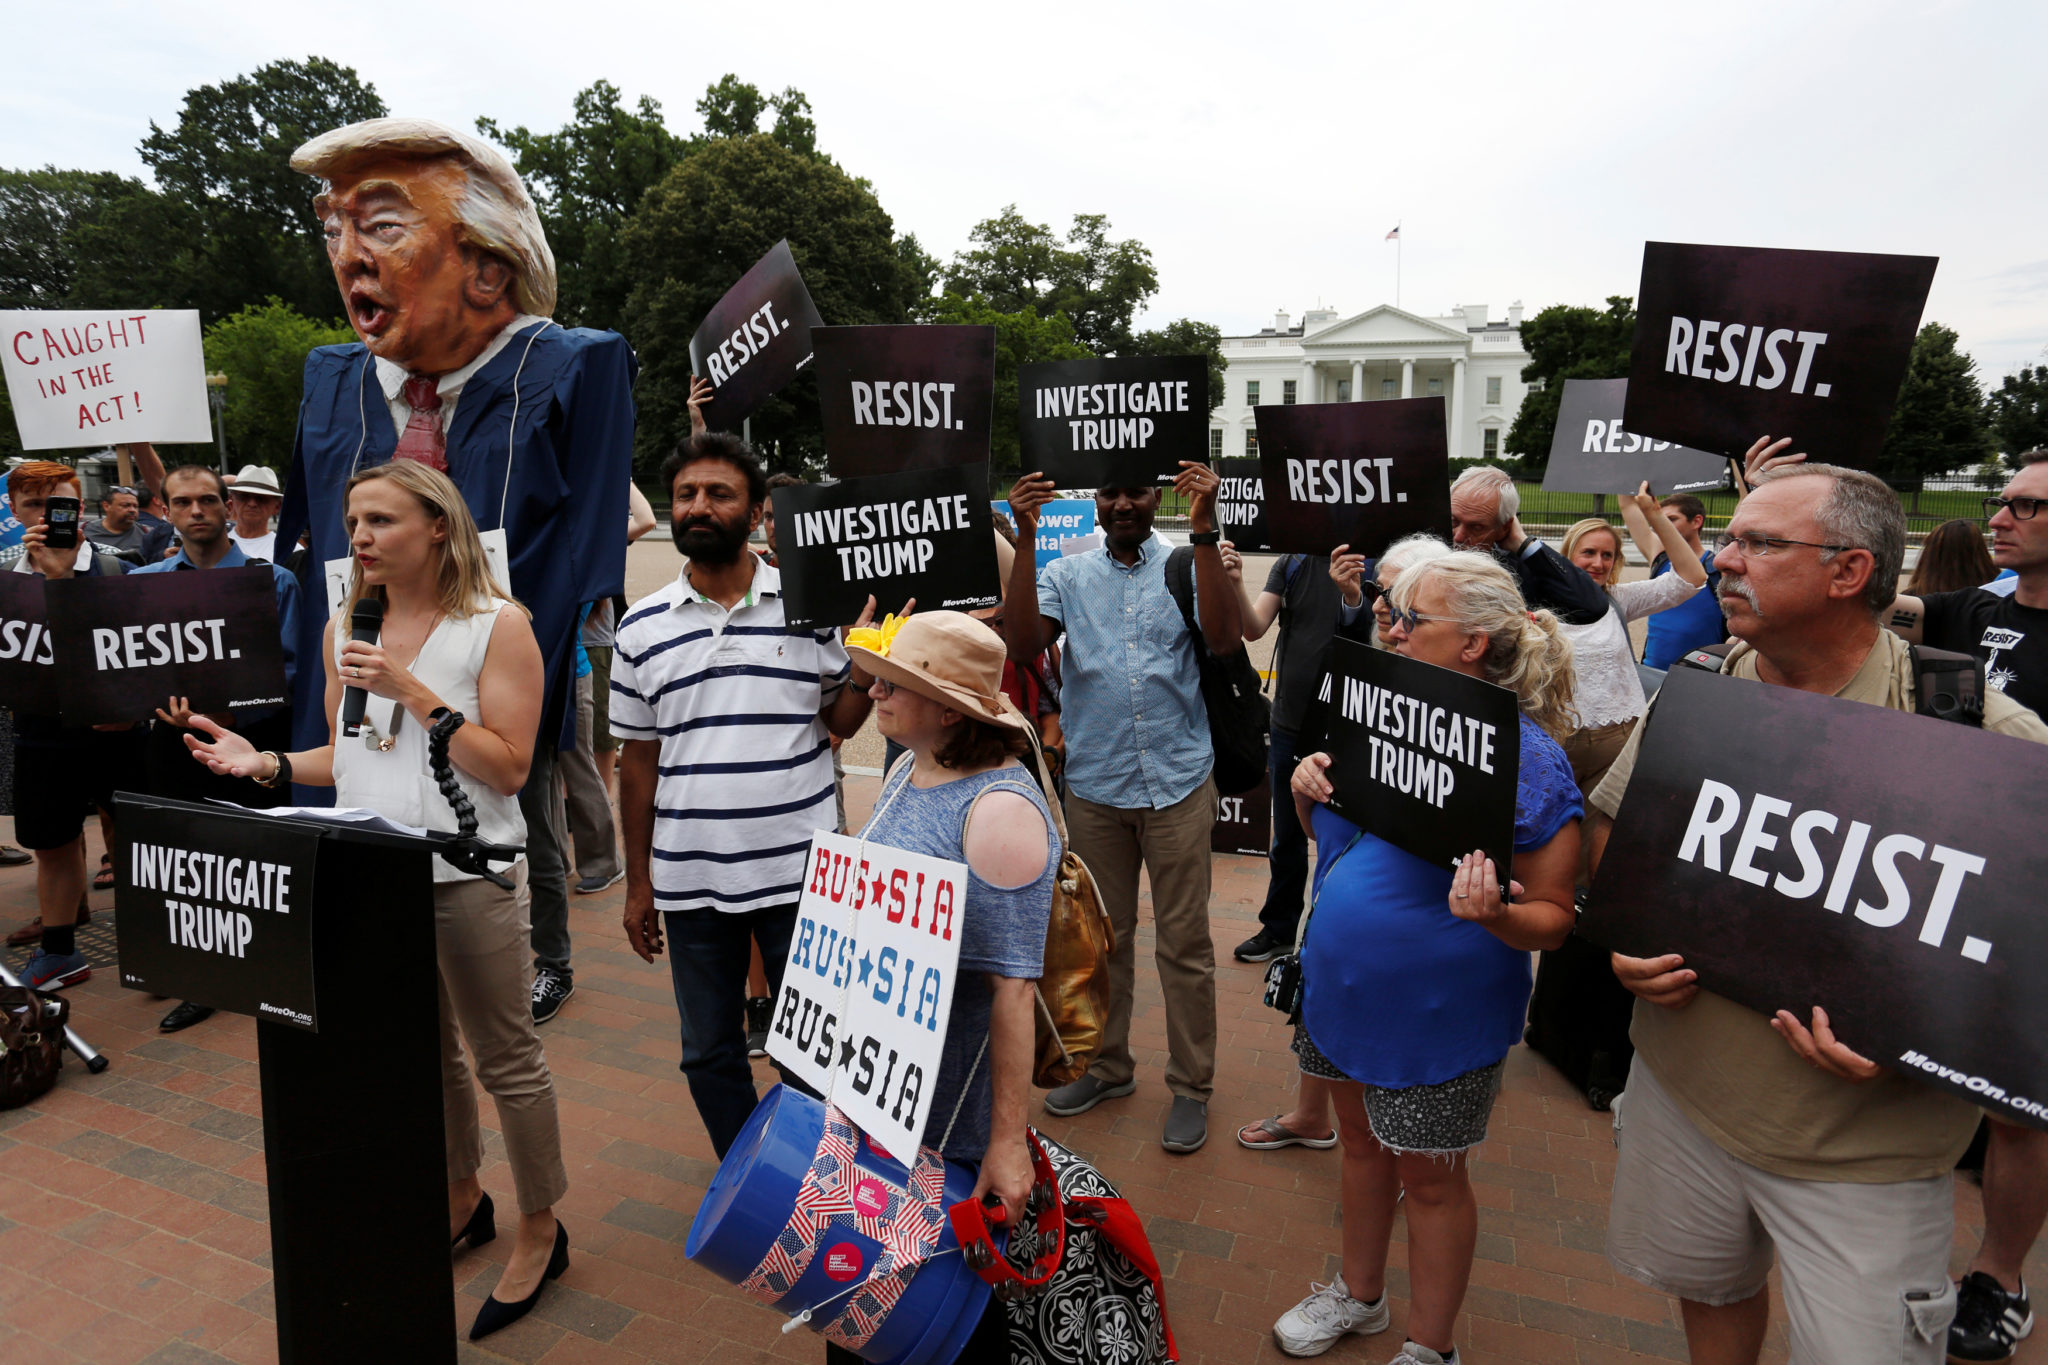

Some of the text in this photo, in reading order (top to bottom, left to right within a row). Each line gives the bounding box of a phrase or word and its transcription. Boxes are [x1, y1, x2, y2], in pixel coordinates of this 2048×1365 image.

[13, 316, 147, 365] CAUGHT
[706, 301, 790, 388] RESIST.
[1665, 316, 1832, 397] RESIST.
[38, 363, 114, 399] IN THE
[851, 381, 964, 430] RESIST.
[1036, 381, 1189, 418] INVESTIGATE
[1069, 418, 1154, 451] TRUMP
[1218, 477, 1265, 501] ESTIGA
[1286, 457, 1408, 504] RESIST.
[794, 494, 971, 547] INVESTIGATE
[1036, 515, 1083, 528] ower
[837, 538, 934, 581] TRUMP
[93, 618, 241, 671] RESIST.
[1341, 675, 1496, 775] INVESTIGATE
[1369, 735, 1455, 809] TRUMP
[131, 842, 292, 914] INVESTIGATE
[1677, 778, 1992, 964] RESIST.
[165, 899, 253, 958] TRUMP
